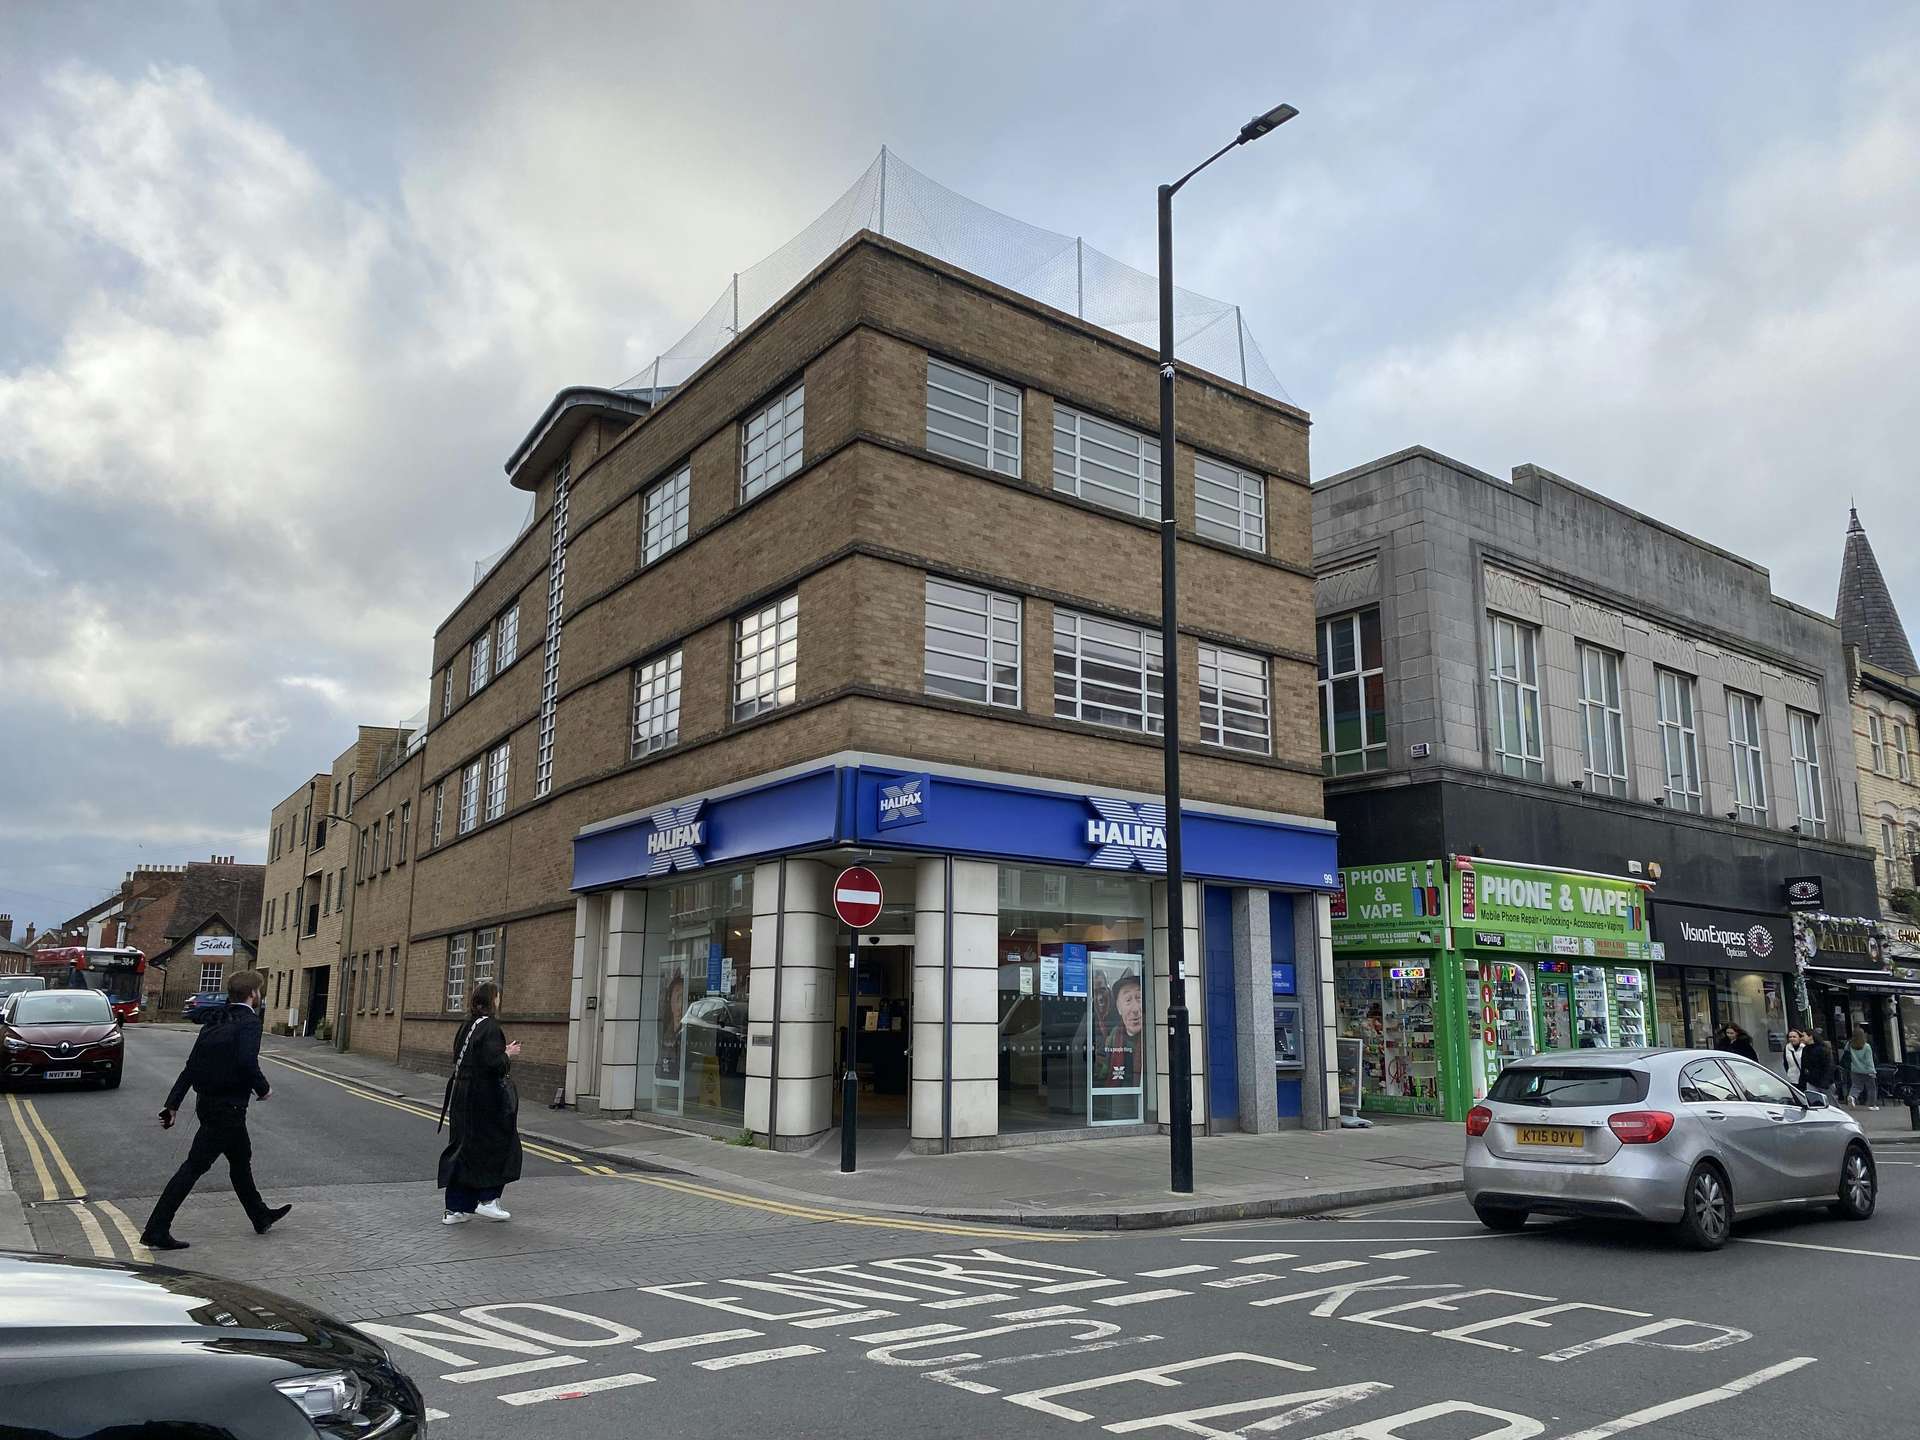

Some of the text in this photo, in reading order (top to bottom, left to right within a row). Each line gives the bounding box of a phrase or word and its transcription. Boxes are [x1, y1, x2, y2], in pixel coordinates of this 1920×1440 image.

[880, 791, 922, 811] HALIFAX
[648, 821, 703, 854] HALIFAX
[1088, 820, 1167, 849] HALIFA
[1323, 873, 1333, 884] 99
[1351, 867, 1407, 886] PHONE
[1374, 886, 1386, 901] &
[1481, 875, 1628, 918] PHONE & VAPE
[1360, 903, 1403, 919] VAPE
[1480, 909, 1624, 934] Mobile Phone Repair Unlocking Accessories Vaping
[1479, 933, 1501, 946] Vaping
[1680, 921, 1746, 949] VisionExpress
[1726, 947, 1748, 959] Opticians
[1486, 1049, 1498, 1090] VAP
[1523, 1129, 1548, 1142] KT15
[352, 1248, 1107, 1367] NO ENTRY
[1250, 1275, 1754, 1362] KEEP
